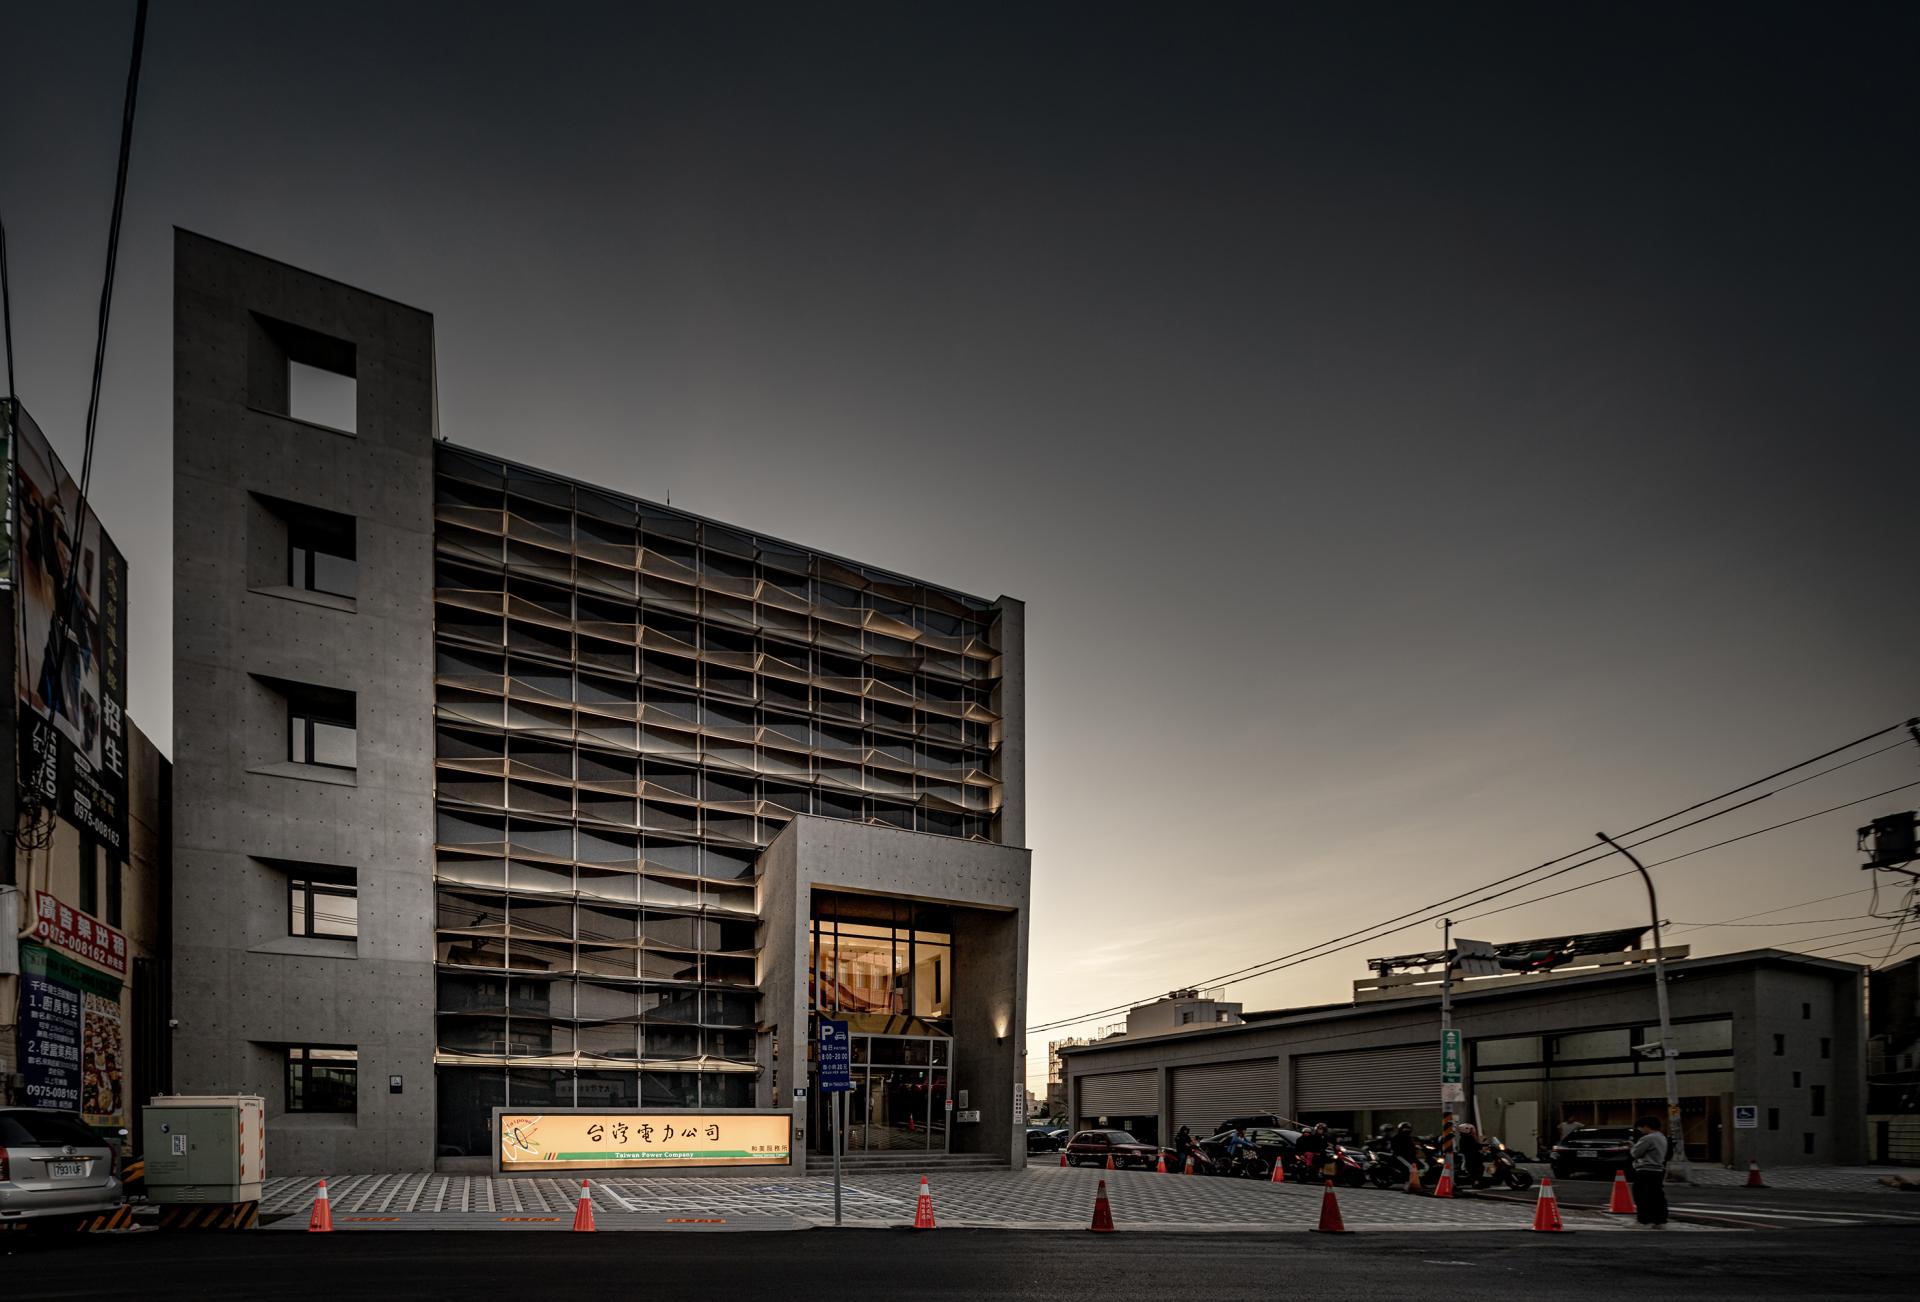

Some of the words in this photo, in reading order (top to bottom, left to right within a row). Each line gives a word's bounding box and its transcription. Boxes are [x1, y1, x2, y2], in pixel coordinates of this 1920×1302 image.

[103, 692, 123, 778] 招生
[73, 801, 120, 848] 0975-008162
[38, 893, 125, 957] 廣告架出租
[38, 920, 106, 964] 0975-008162
[821, 1025, 834, 1041] P
[26, 1084, 78, 1101] 0975-008162
[664, 1151, 694, 1159] Company
